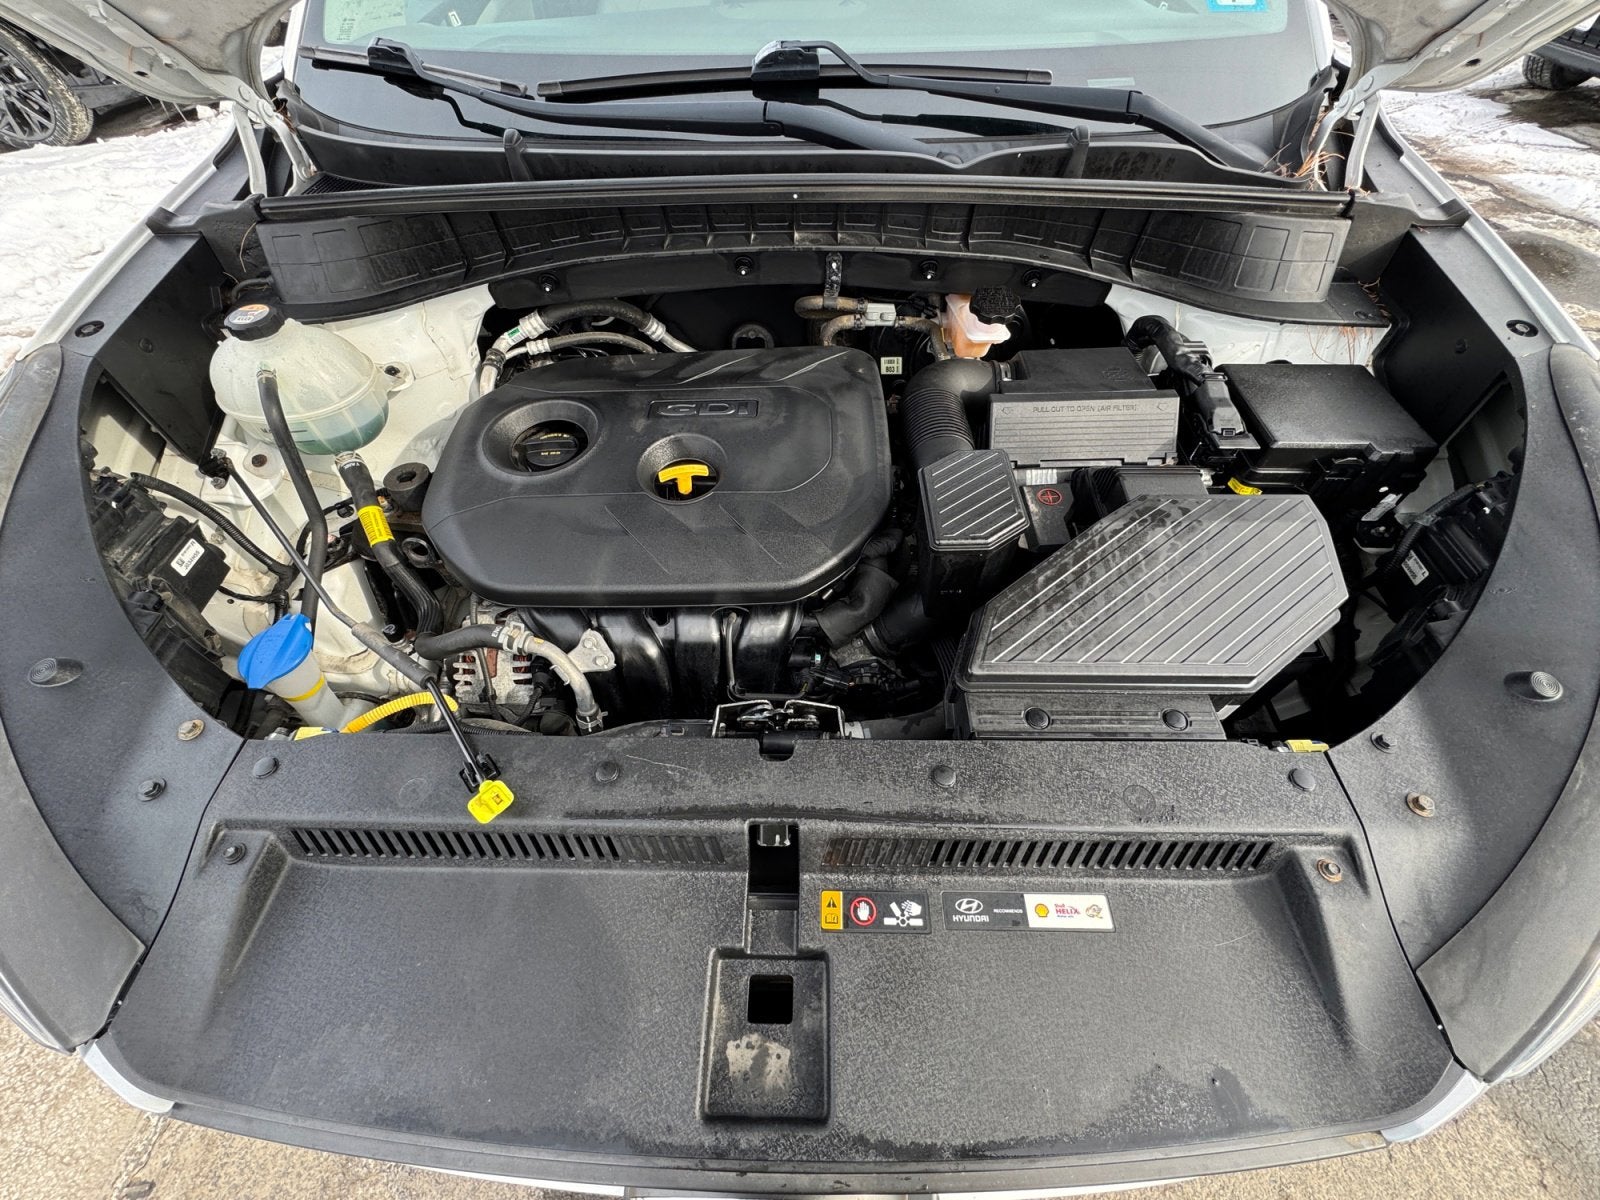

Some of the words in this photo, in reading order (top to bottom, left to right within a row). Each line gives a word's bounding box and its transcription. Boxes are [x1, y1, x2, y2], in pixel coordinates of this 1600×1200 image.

[657, 402, 749, 416] GDI
[1051, 405, 1065, 413] OUT
[952, 914, 990, 923] HYUNDAI
